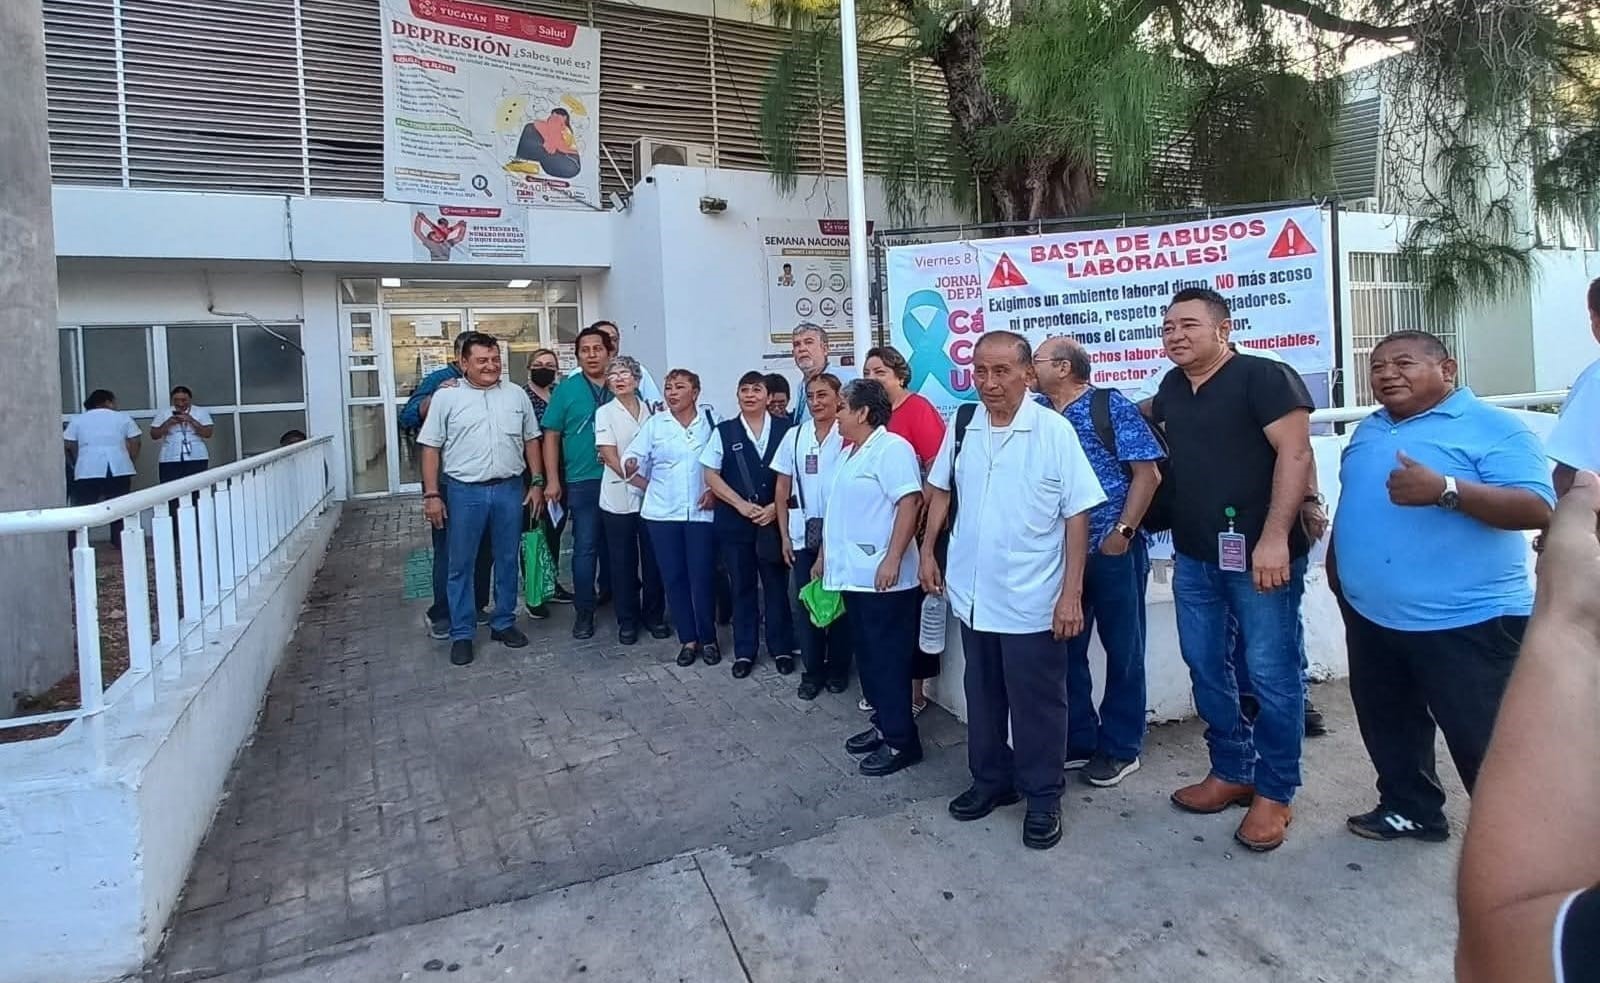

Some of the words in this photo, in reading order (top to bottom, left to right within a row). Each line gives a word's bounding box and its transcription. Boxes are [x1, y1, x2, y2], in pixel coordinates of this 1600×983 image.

[440, 7, 487, 23] YUCATÁN
[538, 25, 567, 38] Salud
[392, 20, 511, 57] DEPRESIÓN
[513, 48, 550, 62] ¿Sabes
[553, 57, 573, 68] qué
[574, 61, 591, 70] es?
[765, 236, 804, 246] SEMANA
[807, 237, 850, 247] NACIONA
[1030, 239, 1109, 263] BASTA
[1116, 234, 1149, 253] DE
[1157, 219, 1266, 248] ABUSOS
[914, 256, 961, 268] Viernes
[964, 253, 972, 264] 8
[1067, 244, 1228, 279] LABORALES!
[935, 275, 982, 288] JORNA
[989, 295, 1041, 313] Exigimos
[1044, 295, 1059, 307] un
[1062, 288, 1119, 305] ambiente
[1122, 281, 1169, 299] laboral
[1215, 273, 1234, 290] NO
[1238, 270, 1266, 288] más
[1270, 267, 1313, 284] acoso
[947, 289, 964, 301] DE
[966, 287, 982, 299] PA
[948, 307, 984, 335] Cá
[1010, 316, 1020, 330] ni
[1023, 309, 1103, 330] prepotencia,
[1105, 304, 1157, 322] respeto
[1226, 292, 1292, 311] ajadores.
[1104, 327, 1116, 342] el
[1119, 324, 1164, 342] cambio
[1088, 350, 1121, 364] echos
[1124, 348, 1168, 362] labora
[1094, 367, 1148, 383] director
